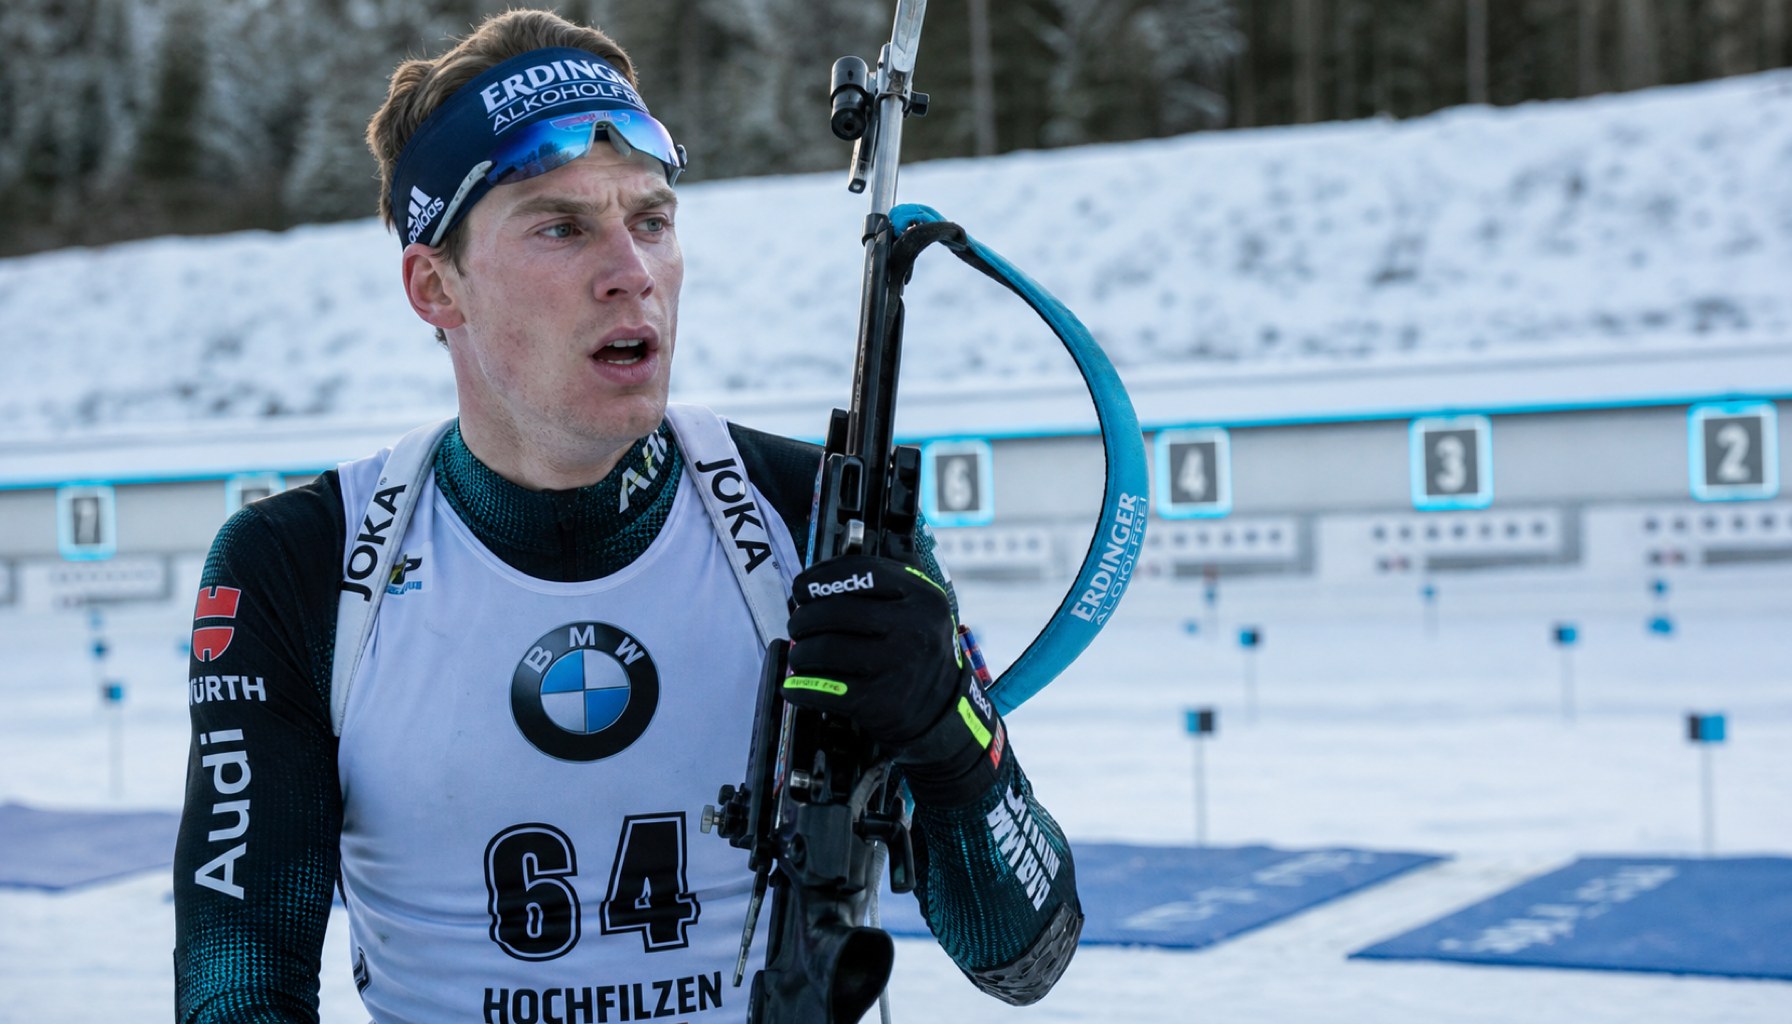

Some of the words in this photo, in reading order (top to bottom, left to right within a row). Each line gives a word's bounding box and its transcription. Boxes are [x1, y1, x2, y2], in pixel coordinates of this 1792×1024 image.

[408, 197, 445, 244] adidas
[1177, 444, 1209, 495] 4
[1435, 434, 1467, 493] 3
[1716, 423, 1751, 483] 2
[943, 457, 973, 510] 6
[338, 484, 407, 602] JOKA
[695, 458, 773, 575] JOKA
[808, 571, 875, 599] Roeckl
[1070, 492, 1138, 622] ERDINGER
[522, 624, 645, 674] BMW
[189, 674, 267, 705] ÜRTH
[194, 728, 251, 900] Audi
[484, 811, 701, 962] 64
[483, 971, 723, 1024] HOCHFILZEN
